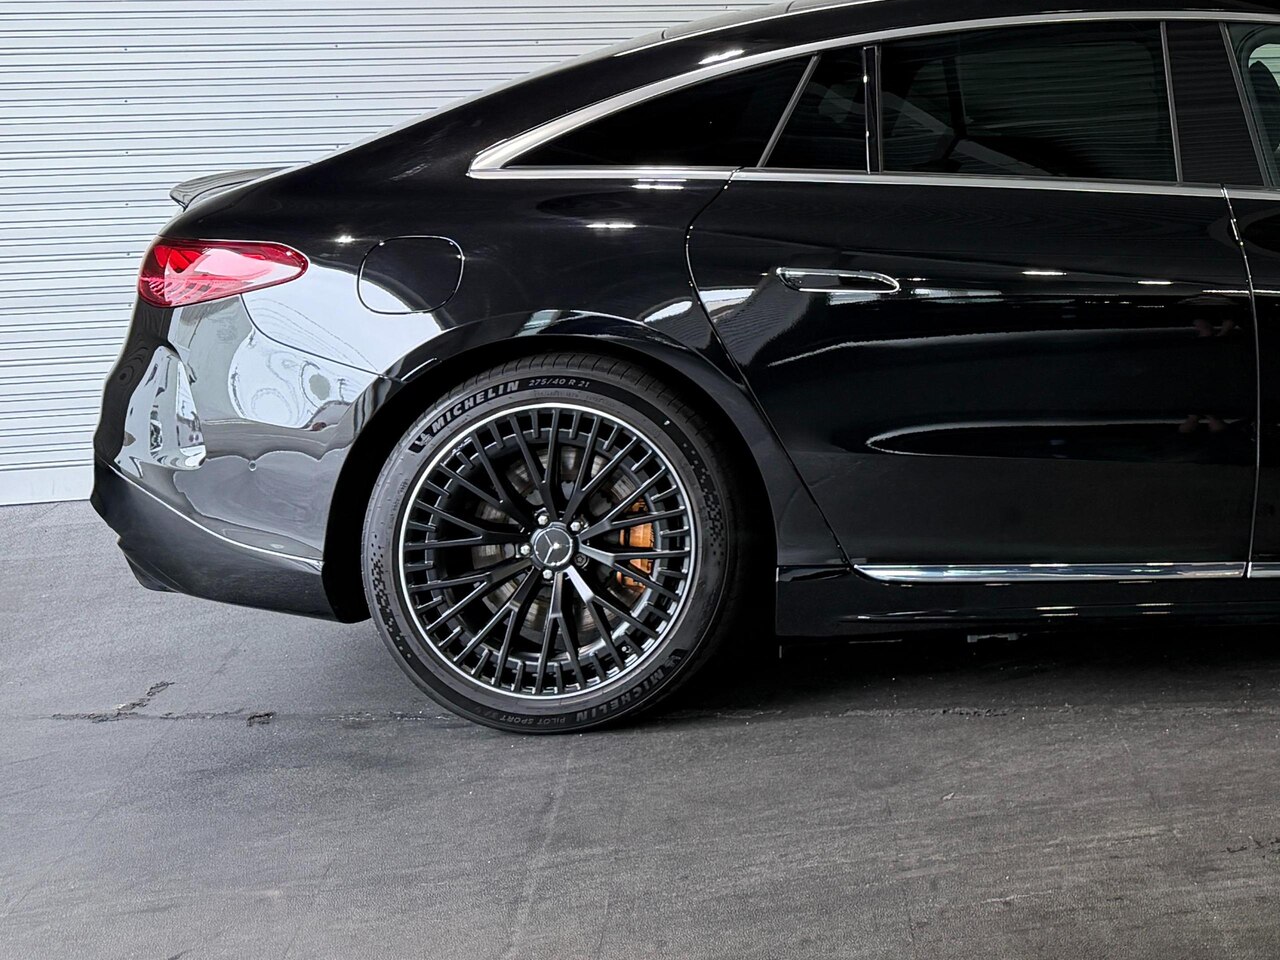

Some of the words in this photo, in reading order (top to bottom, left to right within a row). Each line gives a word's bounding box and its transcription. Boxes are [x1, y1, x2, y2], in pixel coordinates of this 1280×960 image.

[432, 380, 520, 434] MICHELIN
[527, 378, 566, 388] 275/40
[569, 378, 577, 387] R
[577, 379, 590, 388] 21
[576, 668, 665, 723] MICHELIN
[500, 714, 534, 726] SPORT
[537, 715, 566, 726] PILOT
